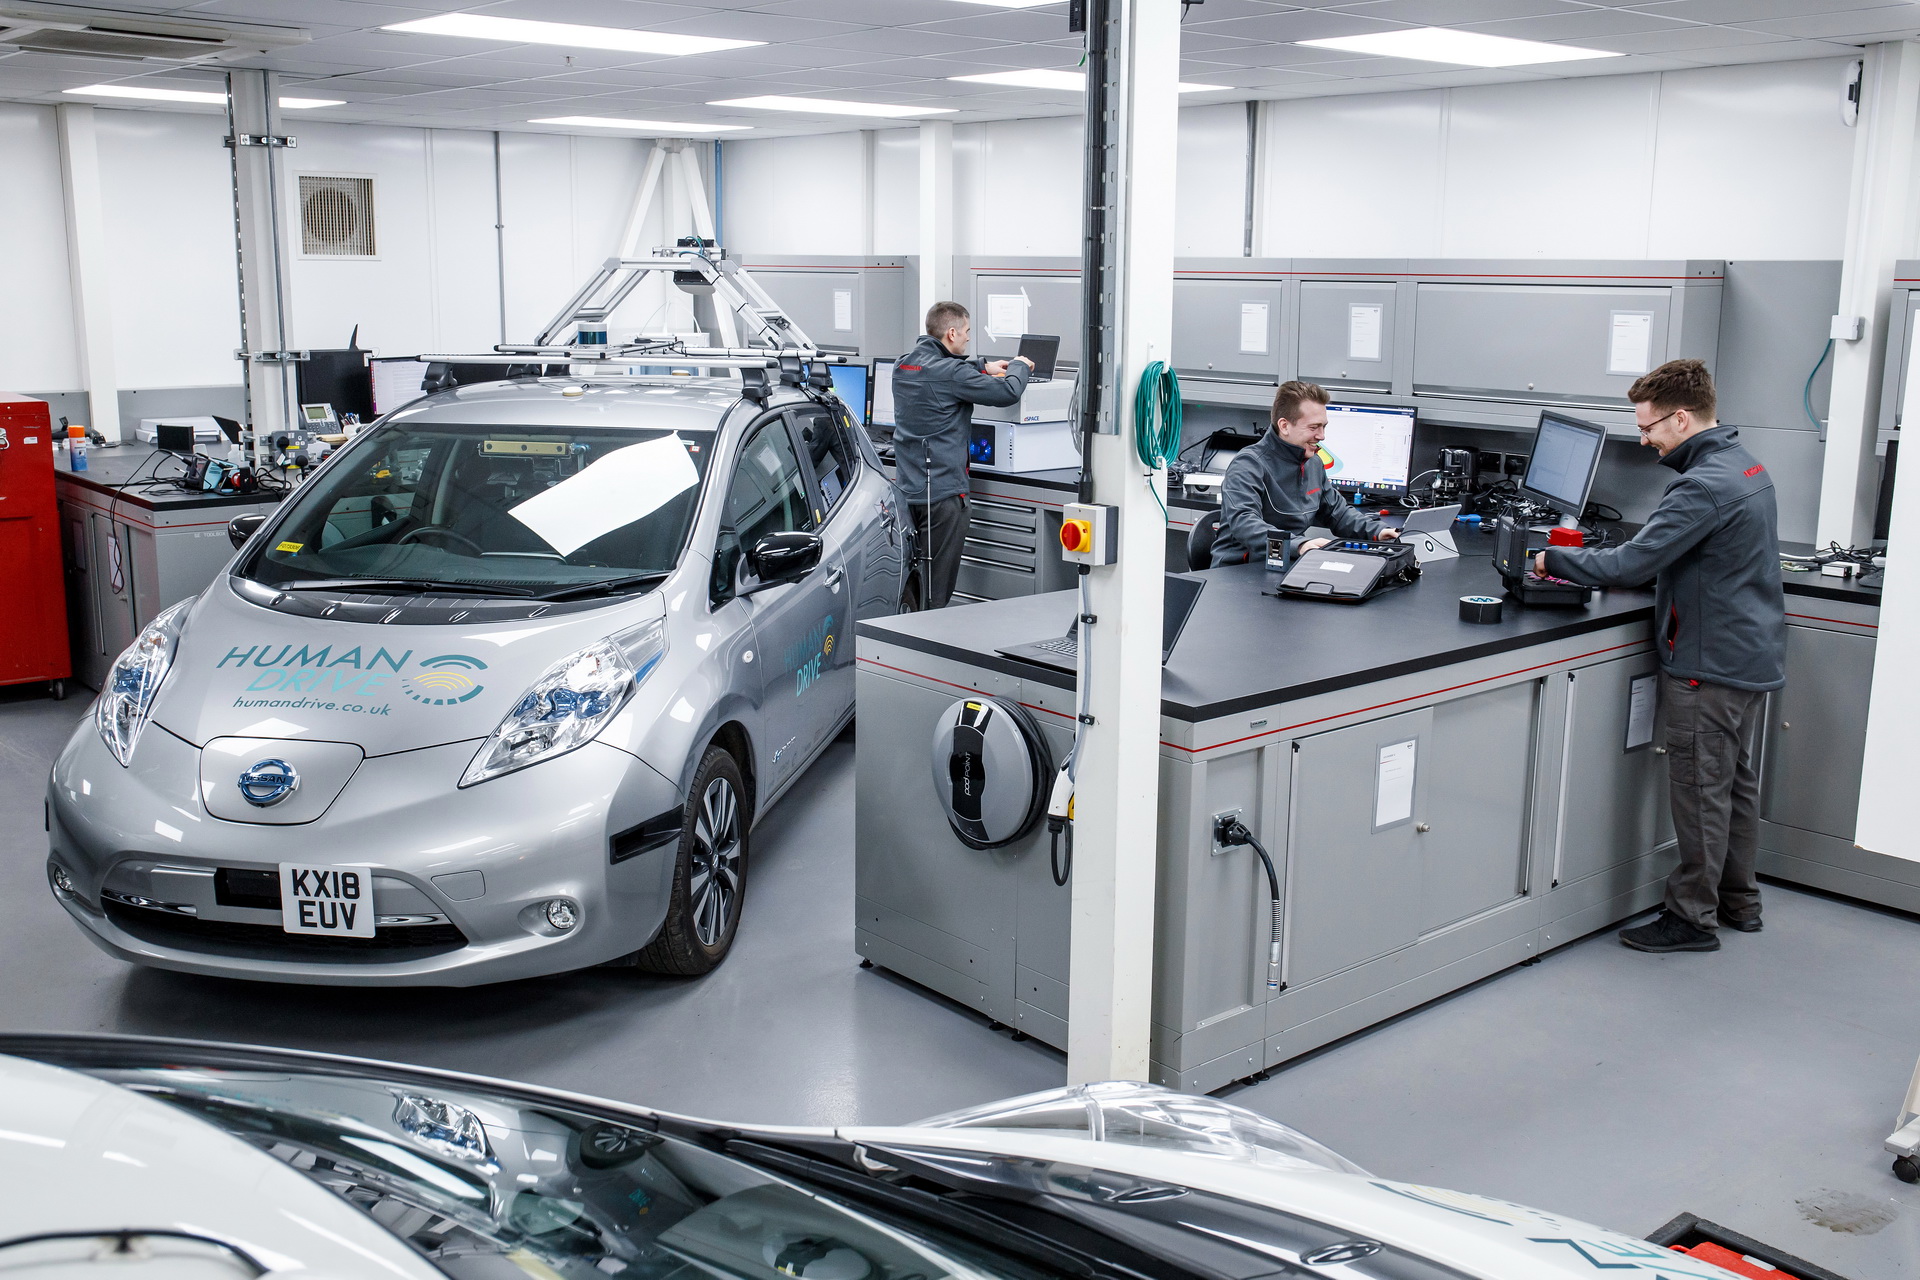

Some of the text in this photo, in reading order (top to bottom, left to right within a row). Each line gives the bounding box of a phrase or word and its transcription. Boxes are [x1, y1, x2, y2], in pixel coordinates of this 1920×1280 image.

[216, 644, 413, 673] HUMAN
[245, 668, 393, 697] DRIVE
[796, 651, 822, 697] DRIVE
[232, 696, 393, 716] humandrive.co.uk
[242, 774, 287, 784] NISSAN
[291, 868, 360, 900] KX18
[298, 899, 357, 931] EUV
